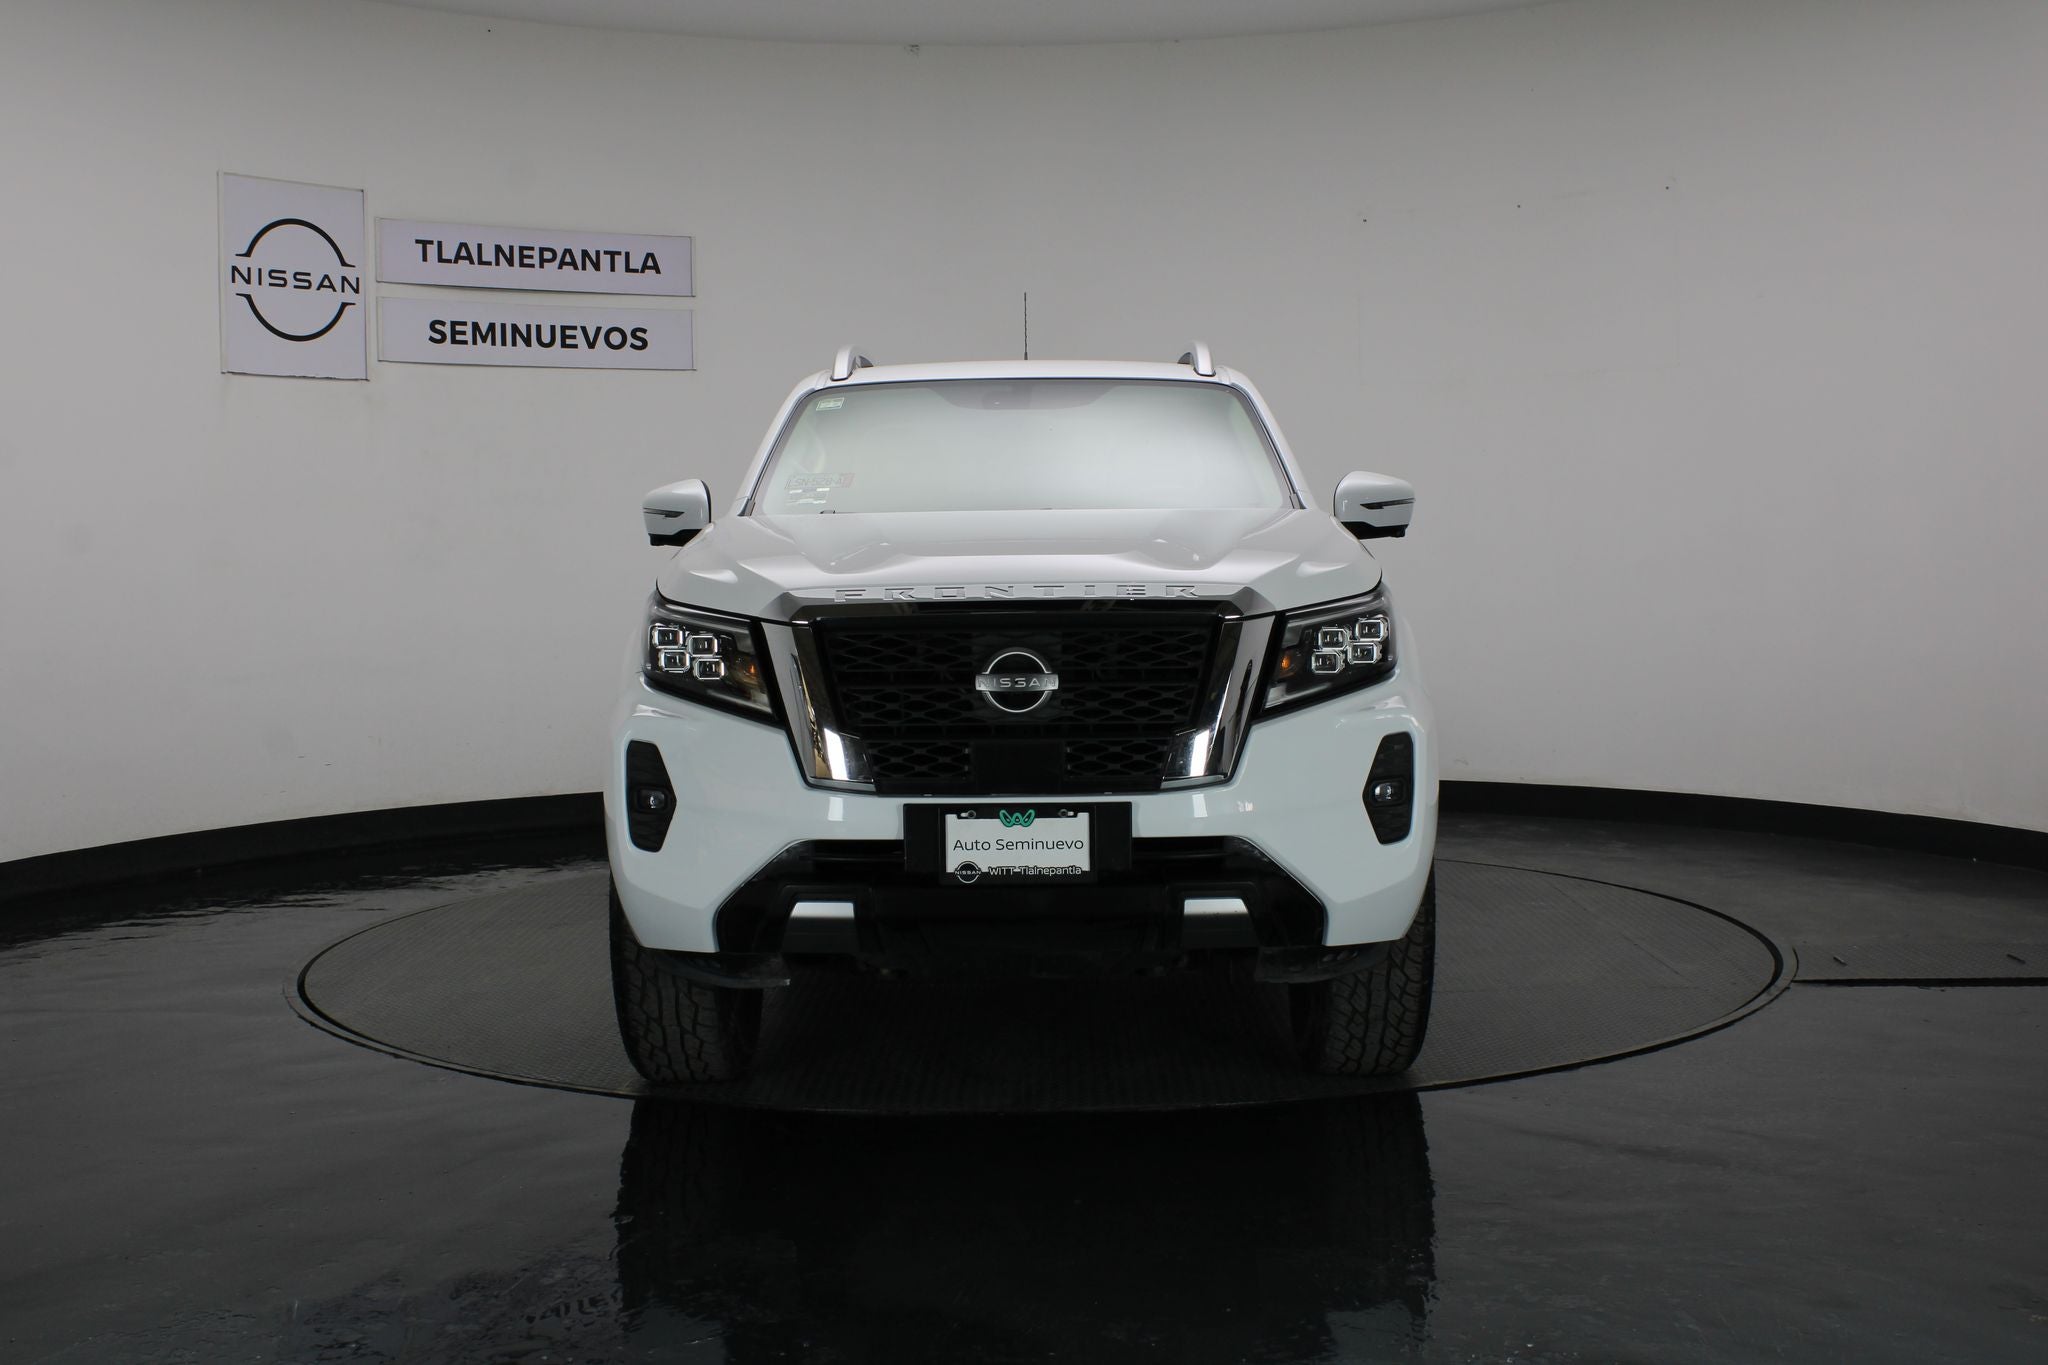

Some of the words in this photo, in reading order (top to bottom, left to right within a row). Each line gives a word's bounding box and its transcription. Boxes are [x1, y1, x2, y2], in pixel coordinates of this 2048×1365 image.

[414, 238, 662, 275] TLALNEPANTLA
[231, 265, 360, 294] NISSAN
[428, 319, 649, 351] SEMINUEVOS
[834, 584, 1199, 602] FRONTIER
[978, 677, 1057, 688] NISSAN
[953, 839, 991, 851] Auto
[995, 838, 1084, 851] Seminuevo
[988, 866, 1015, 876] WITT
[1019, 865, 1082, 877] Tlalnepantla
